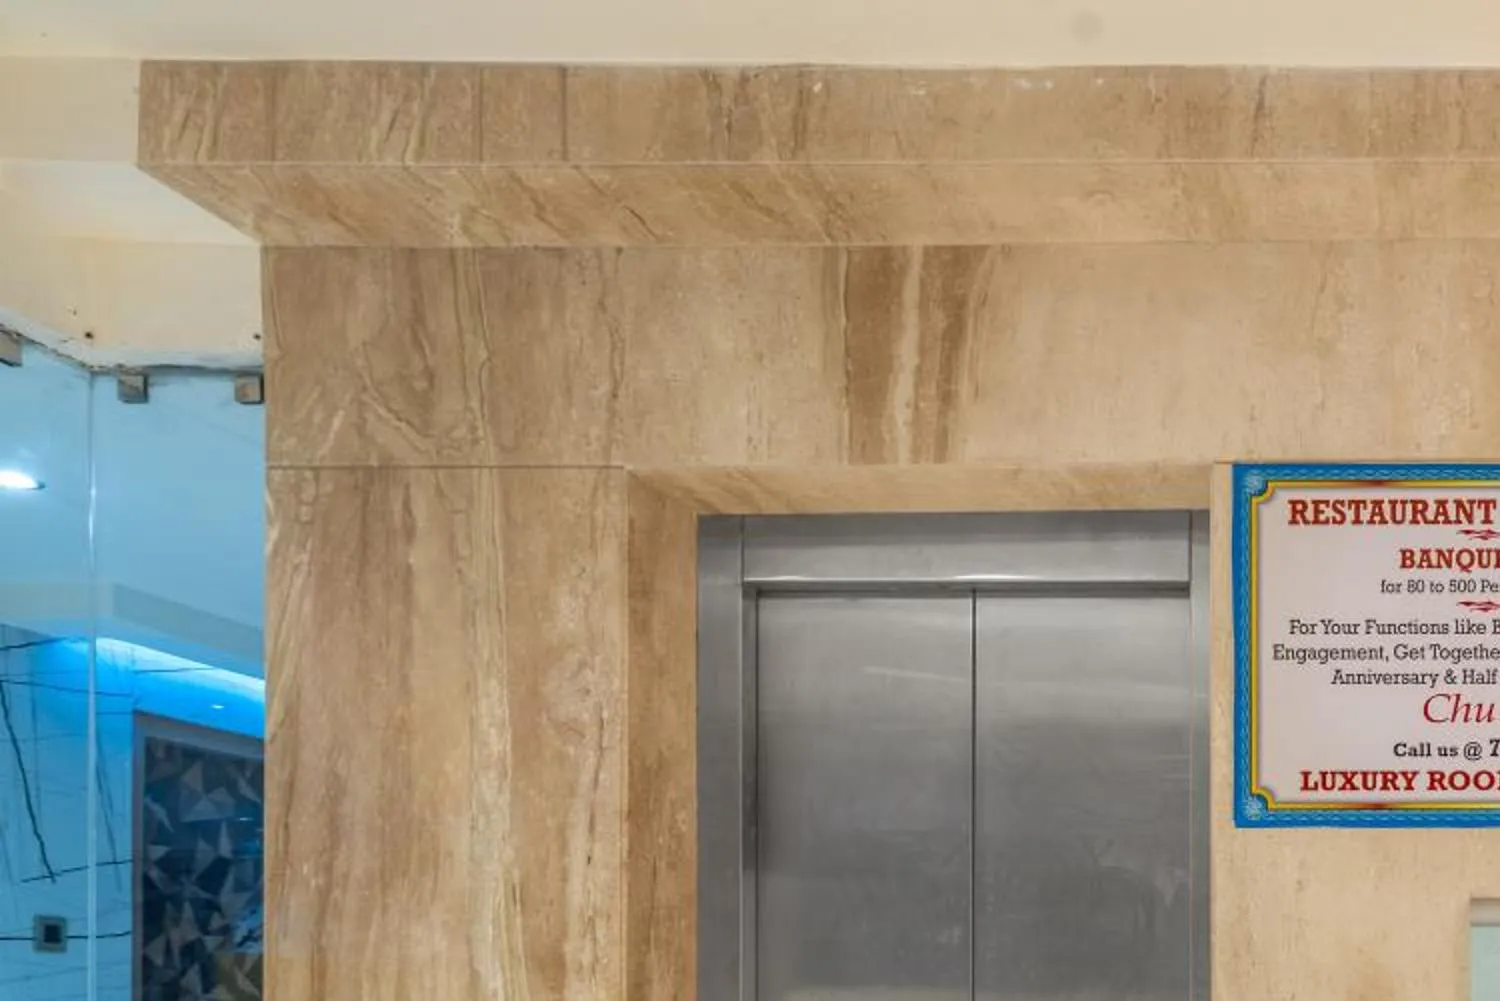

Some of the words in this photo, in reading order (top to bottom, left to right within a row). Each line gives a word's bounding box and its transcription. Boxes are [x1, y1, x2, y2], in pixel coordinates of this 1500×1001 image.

[1288, 498, 1496, 525] RESTAURANT
[1381, 579, 1402, 594] for
[1407, 580, 1425, 594] 80
[1430, 582, 1445, 593] to
[1449, 579, 1476, 593] 500
[1289, 619, 1318, 635] For
[1320, 619, 1360, 635] Your
[1364, 619, 1450, 635] Functions
[1454, 619, 1486, 635] like
[1273, 644, 1389, 665] Engagement,
[1394, 644, 1426, 660] Get
[1331, 669, 1440, 688] Anniversary
[1444, 668, 1457, 685] &
[1462, 668, 1498, 685] Half
[1393, 742, 1432, 758] Call
[1437, 746, 1459, 757] us
[1463, 742, 1482, 761] @
[1300, 770, 1420, 791] LUXURY
